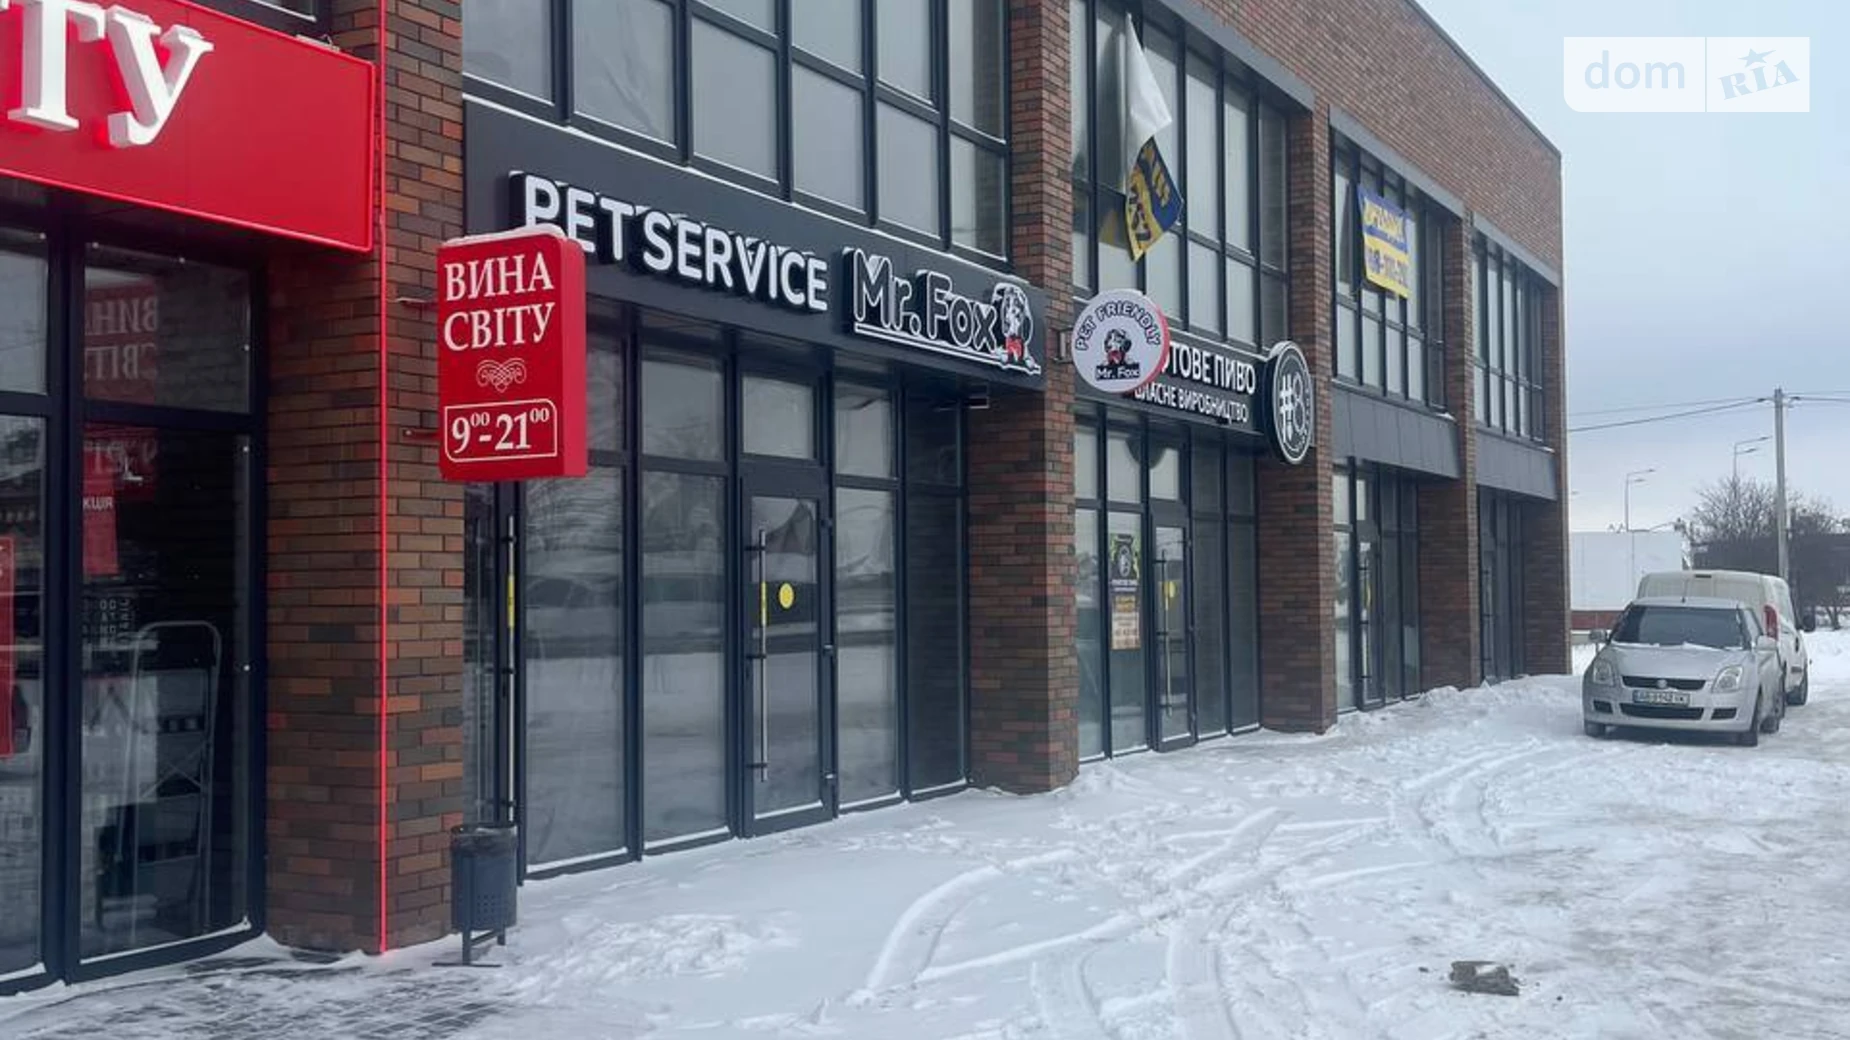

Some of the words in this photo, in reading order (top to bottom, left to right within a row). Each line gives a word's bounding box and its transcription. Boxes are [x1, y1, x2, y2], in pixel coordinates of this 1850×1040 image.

[524, 174, 635, 260] PET
[643, 210, 829, 311] SERVICE
[444, 251, 555, 302] ВИНА
[852, 247, 921, 335] Mr.
[443, 302, 556, 352] СВІТУ
[1075, 315, 1097, 351] PET
[1096, 300, 1161, 346] FRIENDLY
[1161, 341, 1213, 385] ТОВЕ
[1213, 353, 1257, 395] ПИВО
[1178, 387, 1249, 425] ВИРОБНИЦТВО
